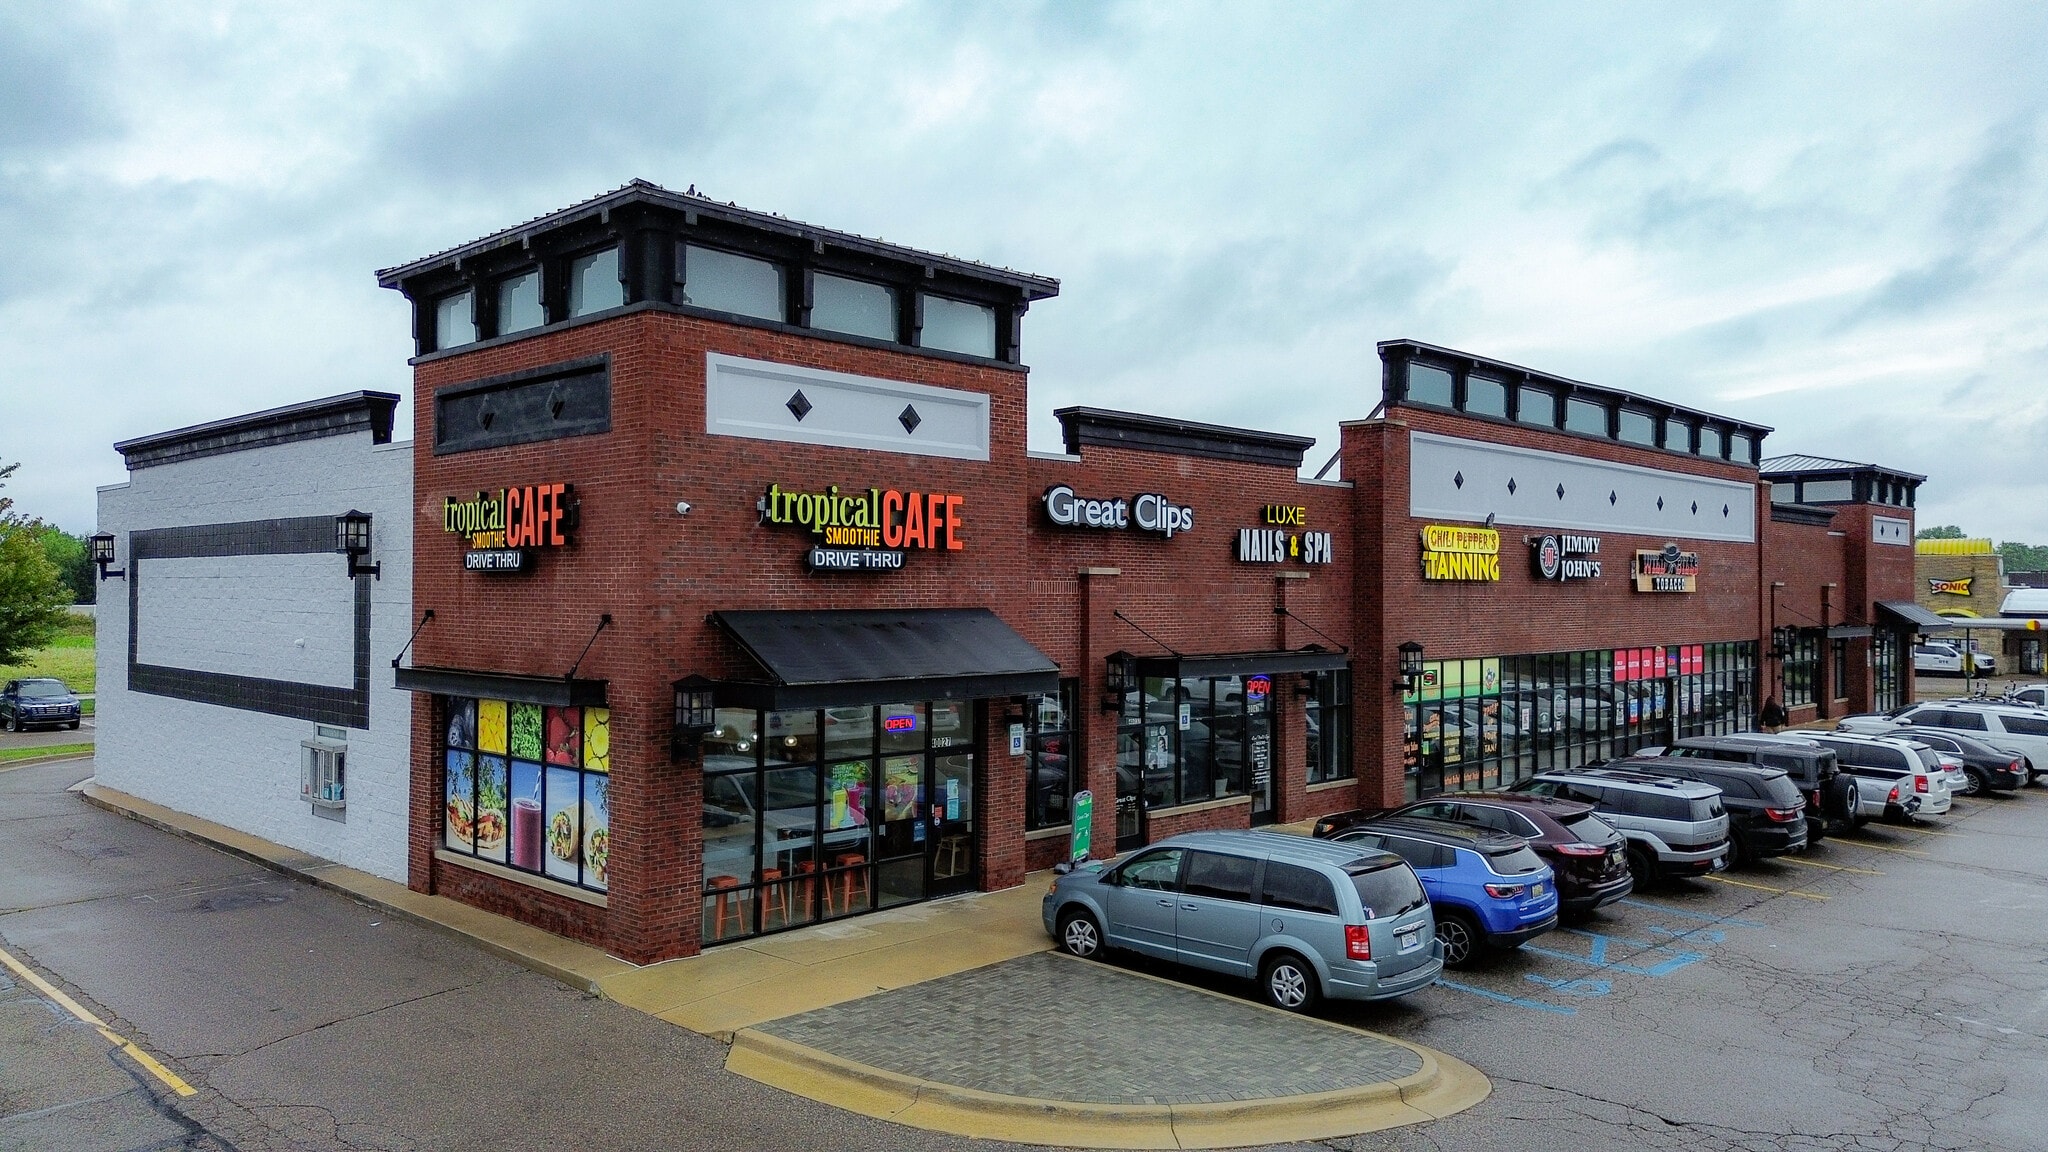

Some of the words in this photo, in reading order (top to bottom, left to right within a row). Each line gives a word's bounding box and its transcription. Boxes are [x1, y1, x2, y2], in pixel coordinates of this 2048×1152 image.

[443, 488, 505, 539] tropical
[506, 483, 565, 548] CAFE
[769, 483, 880, 533] tropical
[882, 489, 964, 551] CAFE
[1048, 486, 1127, 527] Great
[1134, 494, 1193, 538] Clips
[1266, 505, 1306, 525] LUXE
[472, 530, 506, 549] SMOOTHIE
[826, 527, 880, 546] SMOOTHIE
[1240, 528, 1285, 563] NAILS
[1289, 535, 1299, 557] &
[1304, 531, 1332, 564] SPA
[1430, 529, 1455, 548] CHILI
[1456, 531, 1497, 551] PEPPER'S
[1561, 535, 1601, 556] JIMMY
[466, 554, 493, 569] DRIVE
[495, 552, 520, 568] THRU
[815, 551, 860, 567] DRIVE
[863, 552, 902, 568] THRU
[1427, 551, 1500, 580] TANNING
[1560, 560, 1601, 582] JOHN'S
[1656, 577, 1685, 591] TOBACCO
[1933, 582, 1968, 592] SONIC
[1246, 680, 1271, 694] OPEN
[884, 718, 913, 730] OPEN
